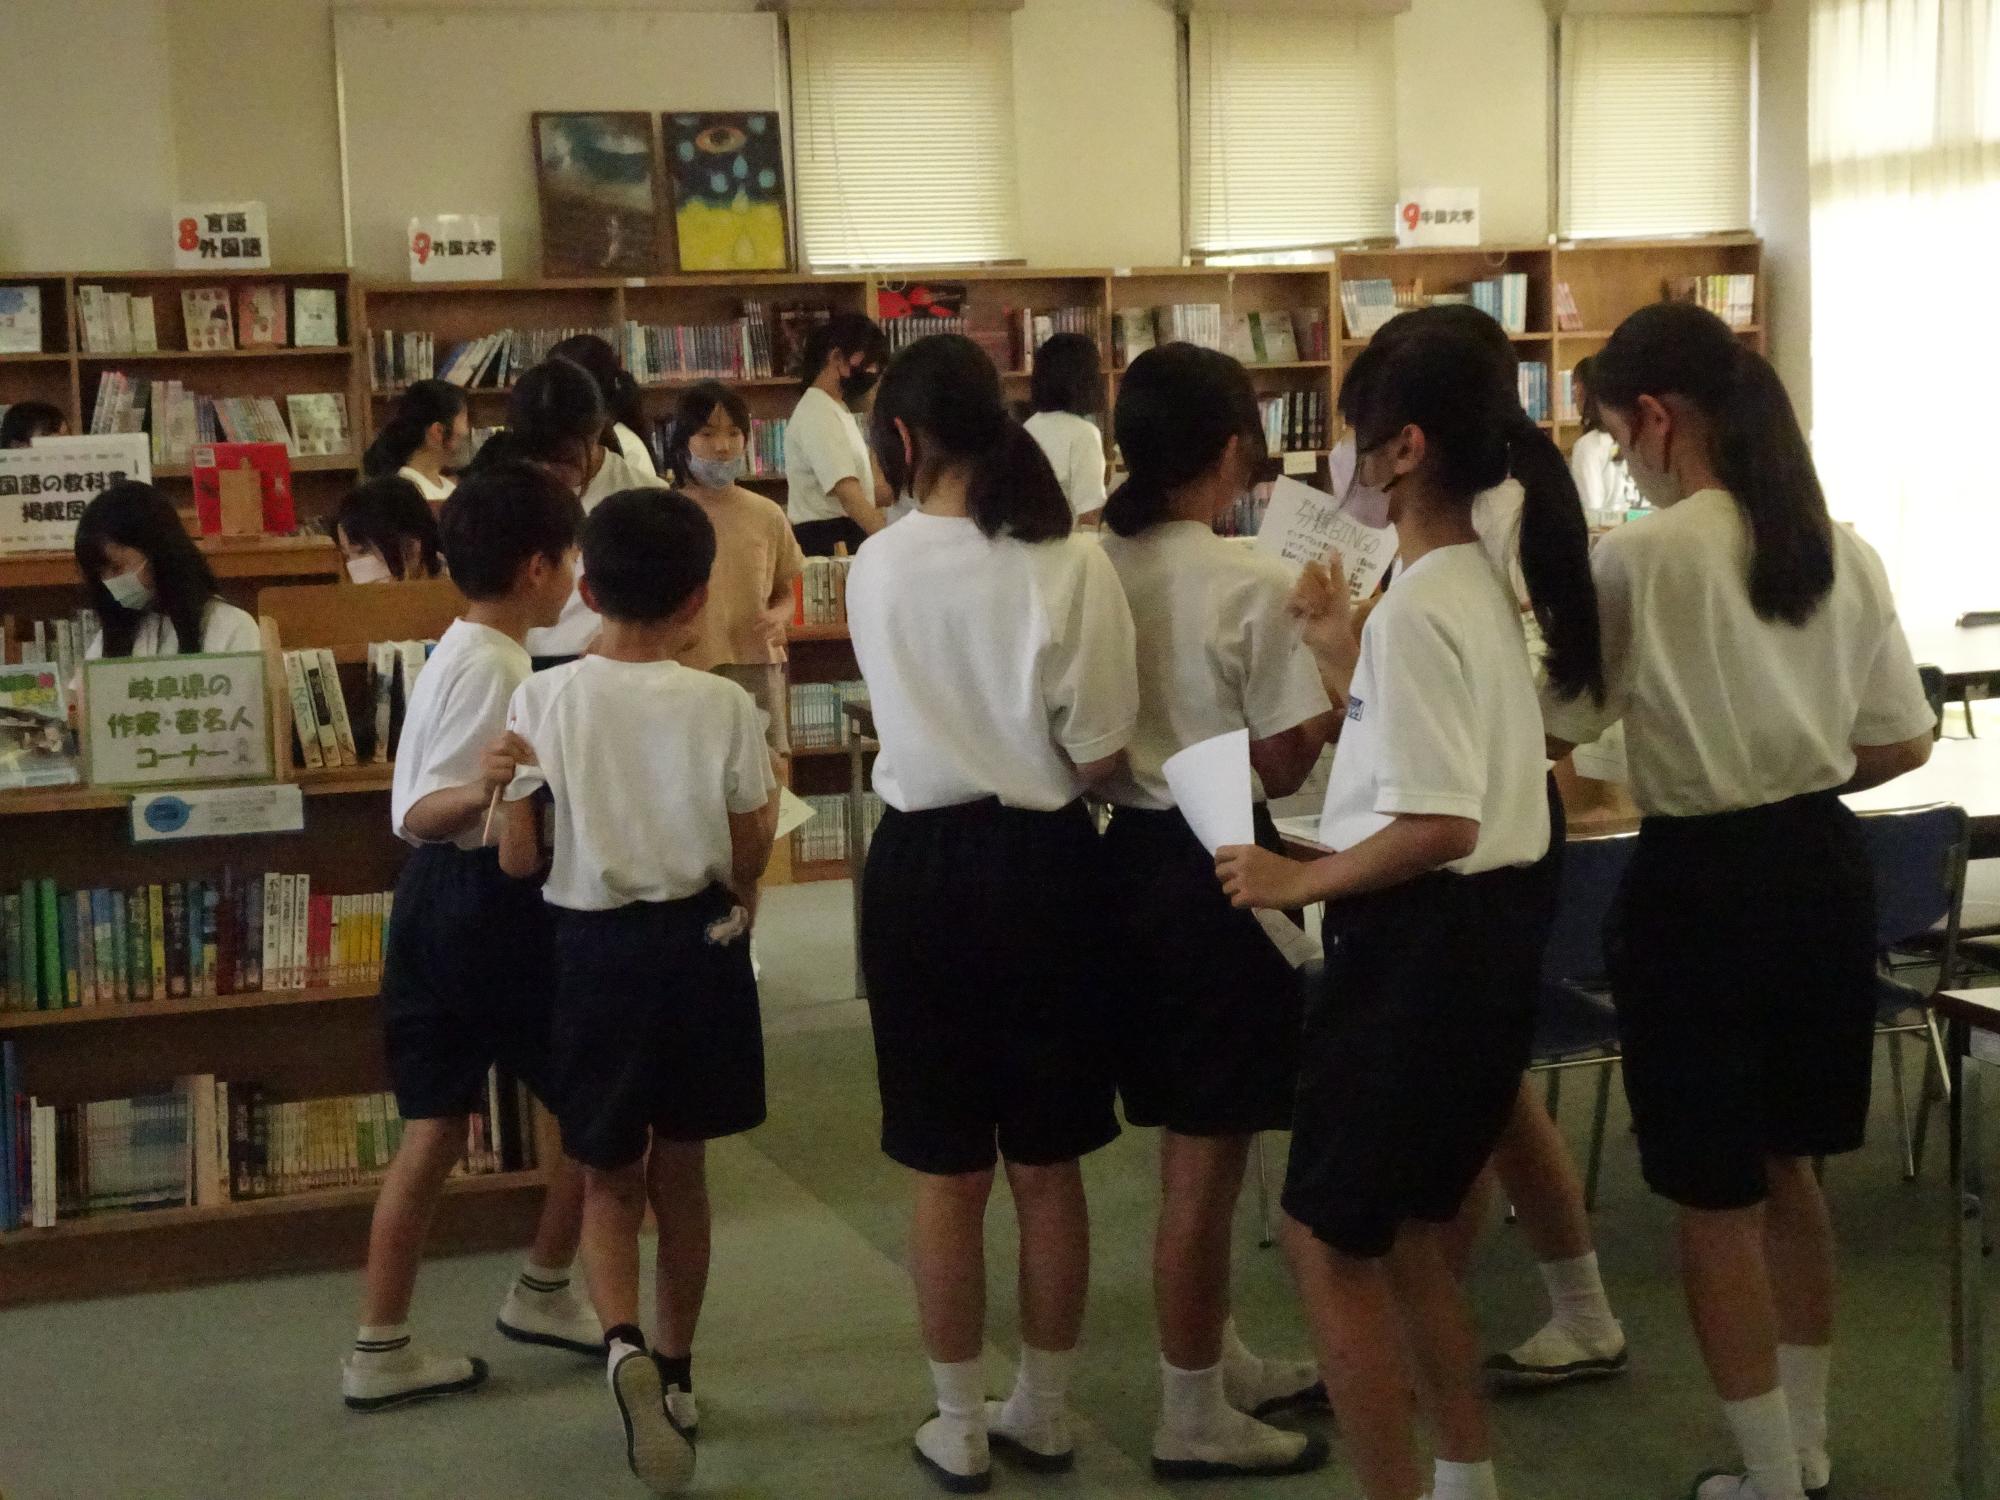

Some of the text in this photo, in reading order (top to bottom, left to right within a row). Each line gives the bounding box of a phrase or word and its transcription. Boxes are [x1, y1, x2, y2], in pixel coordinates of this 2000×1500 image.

[1403, 203, 1420, 230] 9
[178, 217, 199, 251] 8
[199, 237, 262, 258] 外国語
[412, 232, 431, 265] 9
[128, 673, 232, 701] 岐阜県の
[107, 705, 254, 739] 作家・著名人
[136, 743, 229, 769] コーナー
